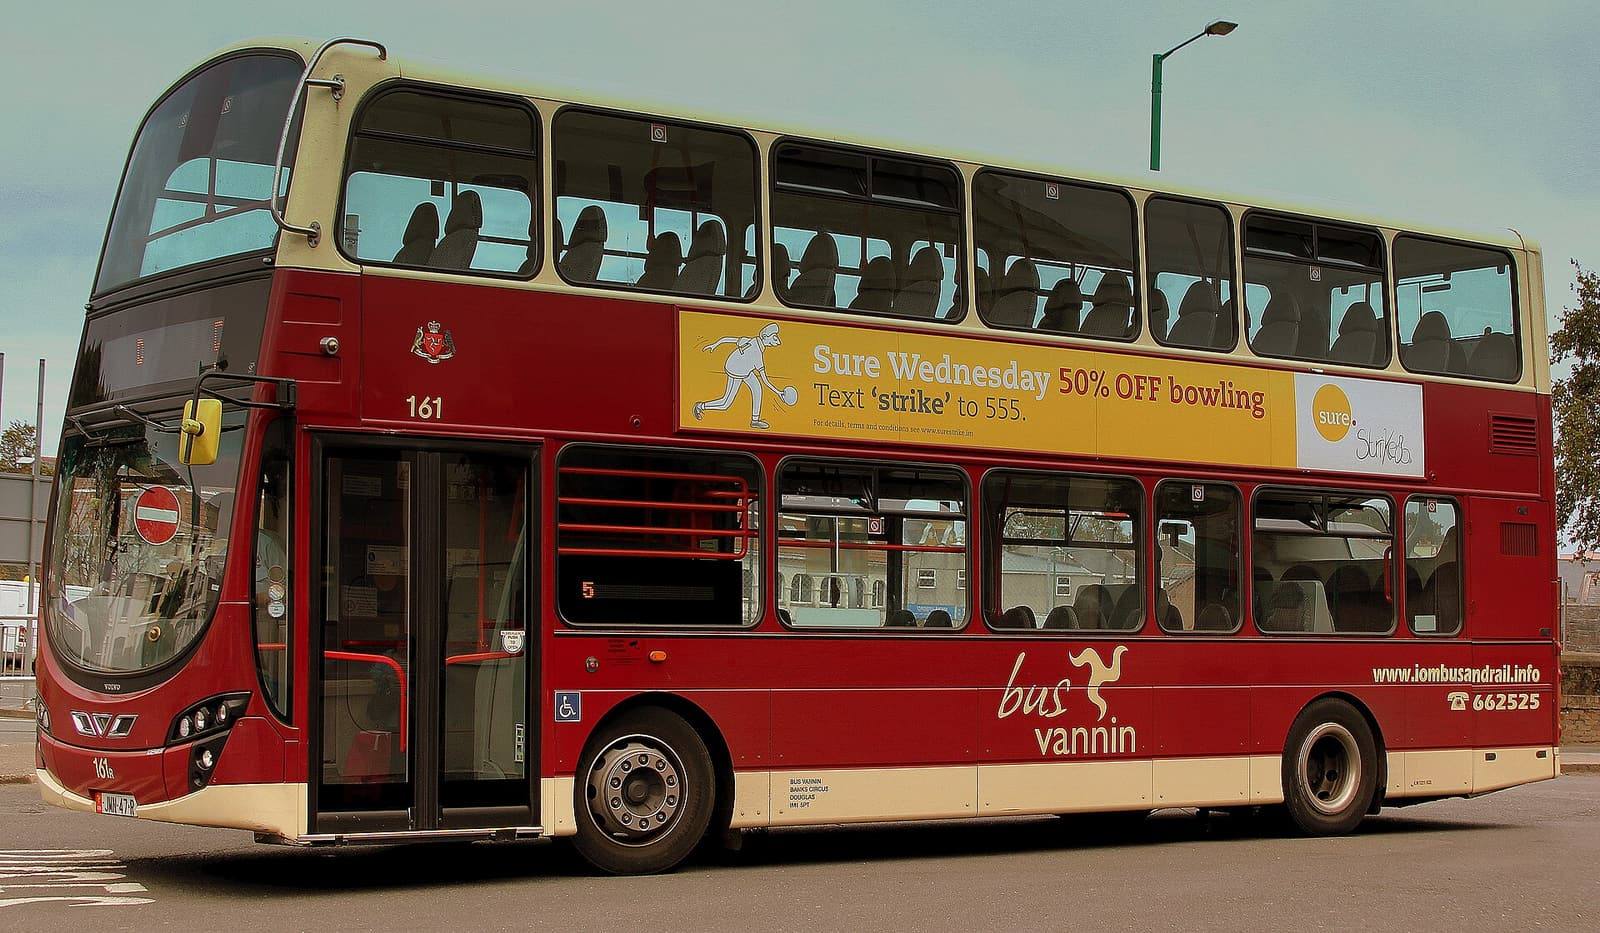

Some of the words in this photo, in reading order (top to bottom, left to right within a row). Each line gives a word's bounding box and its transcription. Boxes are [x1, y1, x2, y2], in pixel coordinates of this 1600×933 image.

[813, 344, 881, 378] Sure
[887, 351, 1051, 401] Wednesday
[1058, 367, 1110, 398] 50%
[1115, 373, 1162, 402] OFF
[1167, 375, 1265, 419] bowling
[406, 395, 442, 419] 161
[813, 383, 865, 409] Text
[958, 396, 978, 417] to
[986, 397, 1026, 421] 555.
[813, 419, 823, 427] For
[824, 420, 846, 429] details,
[847, 422, 865, 430] terms
[866, 422, 878, 430] and
[879, 424, 909, 433] conditions
[582, 581, 595, 599] 5
[1372, 663, 1541, 683] www.iombusandrail.info
[998, 651, 1071, 719] bus
[1472, 693, 1541, 711] 662525
[1034, 716, 1137, 756] vannin
[808, 785, 829, 793] CIRCUS
